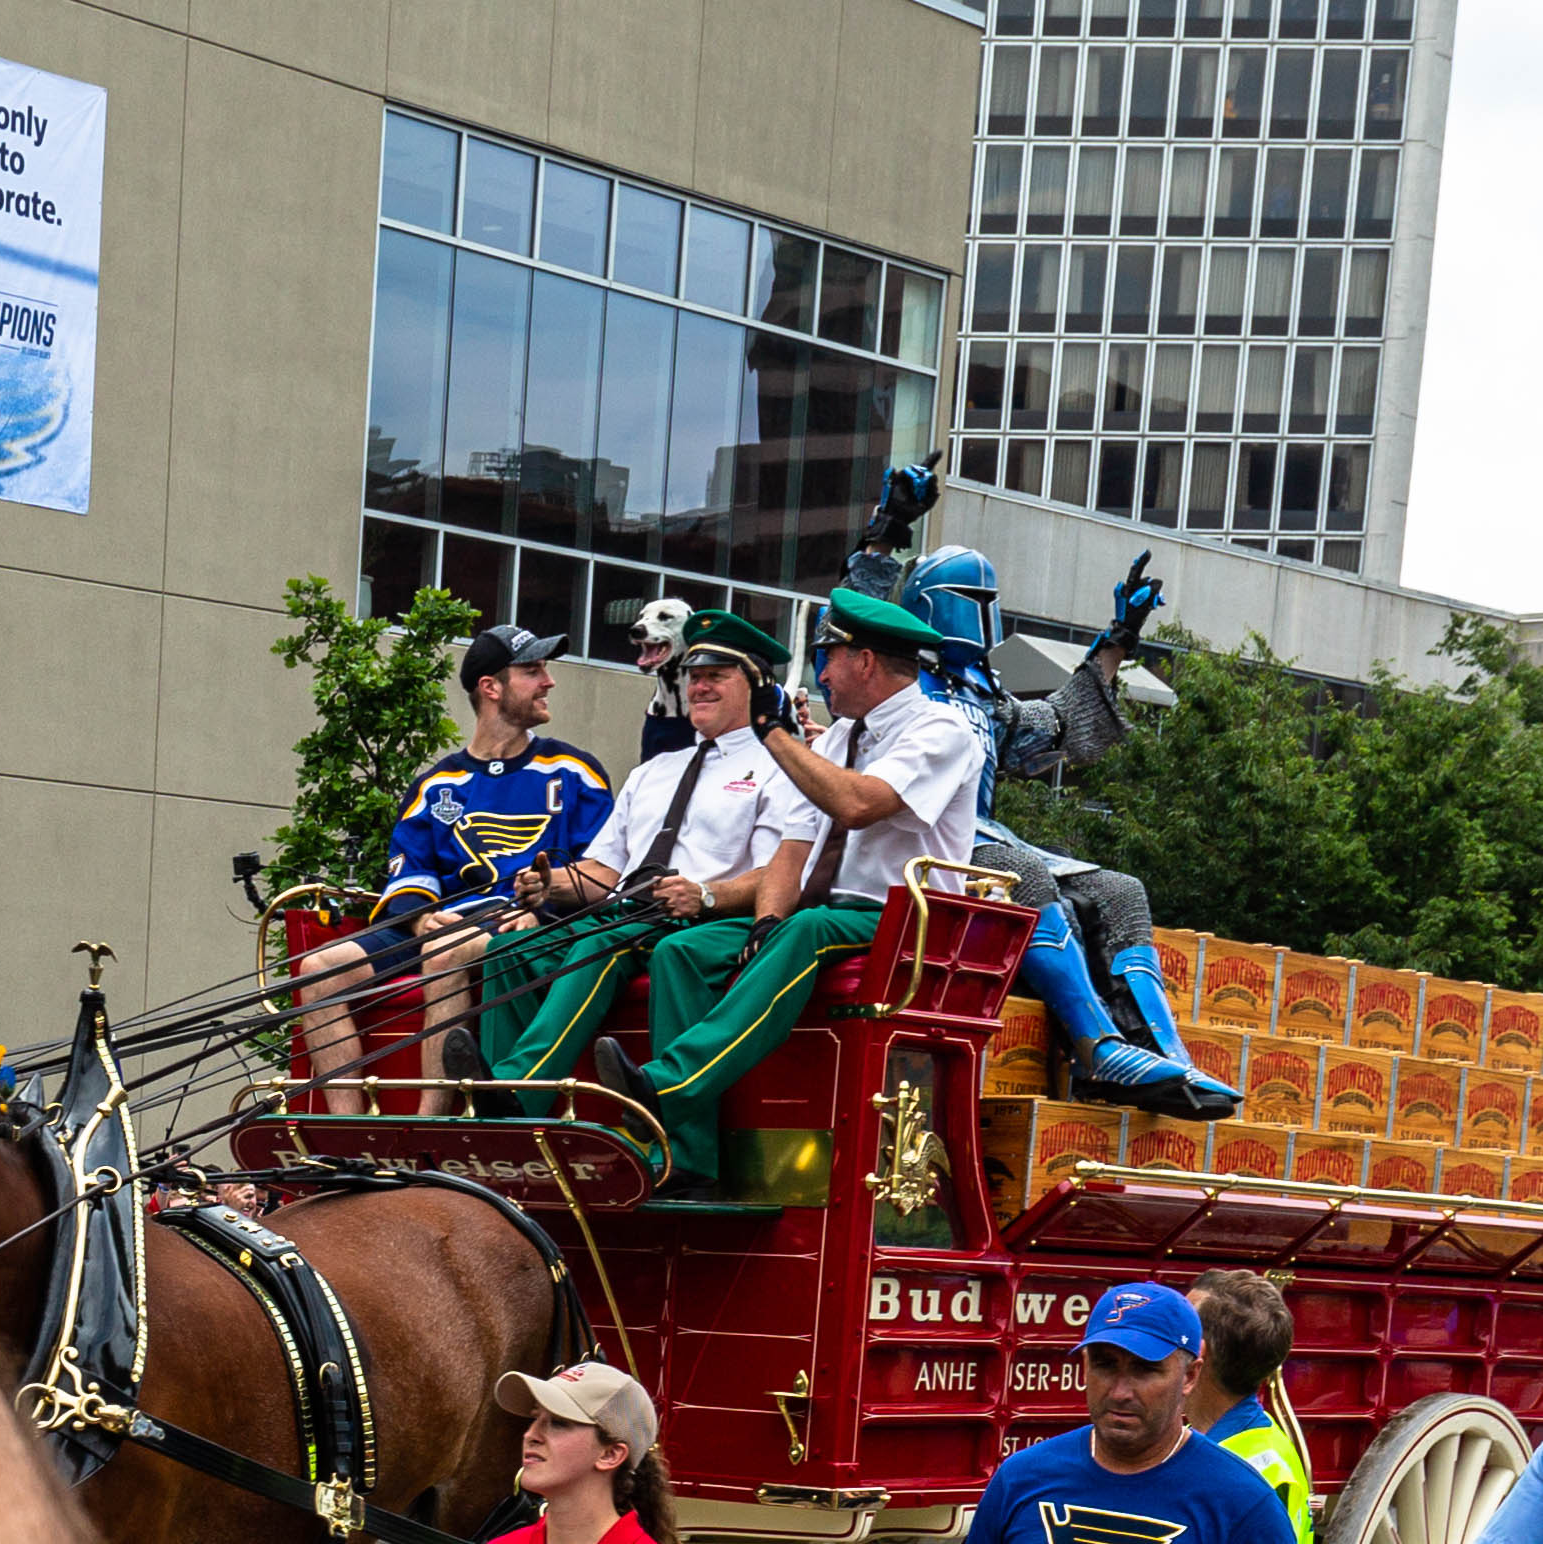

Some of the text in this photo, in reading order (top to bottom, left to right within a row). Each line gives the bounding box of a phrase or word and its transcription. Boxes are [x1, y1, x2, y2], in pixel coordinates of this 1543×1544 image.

[0, 142, 25, 176] to
[1207, 956, 1267, 1007] BUDWEISER
[1284, 969, 1342, 1018] BUDWEISER
[1357, 982, 1412, 1028] BUDWEISER
[1425, 993, 1478, 1039] BUDWEISER
[1490, 1005, 1540, 1049] BUDWEISER
[1250, 1051, 1311, 1099] BUDWEISER
[1326, 1061, 1384, 1108] BUDWEISER
[1398, 1072, 1453, 1116] BUDWEISER
[1467, 1082, 1518, 1125] BUDWEISER
[1039, 1120, 1110, 1166] BUDWEISER
[1130, 1128, 1196, 1172] BUDWEISER
[1216, 1138, 1277, 1179] BUDWEISER
[1296, 1148, 1354, 1187] BUDWEISER
[1371, 1155, 1427, 1193] BUDWEISER
[1443, 1162, 1496, 1199] BUDWEISER
